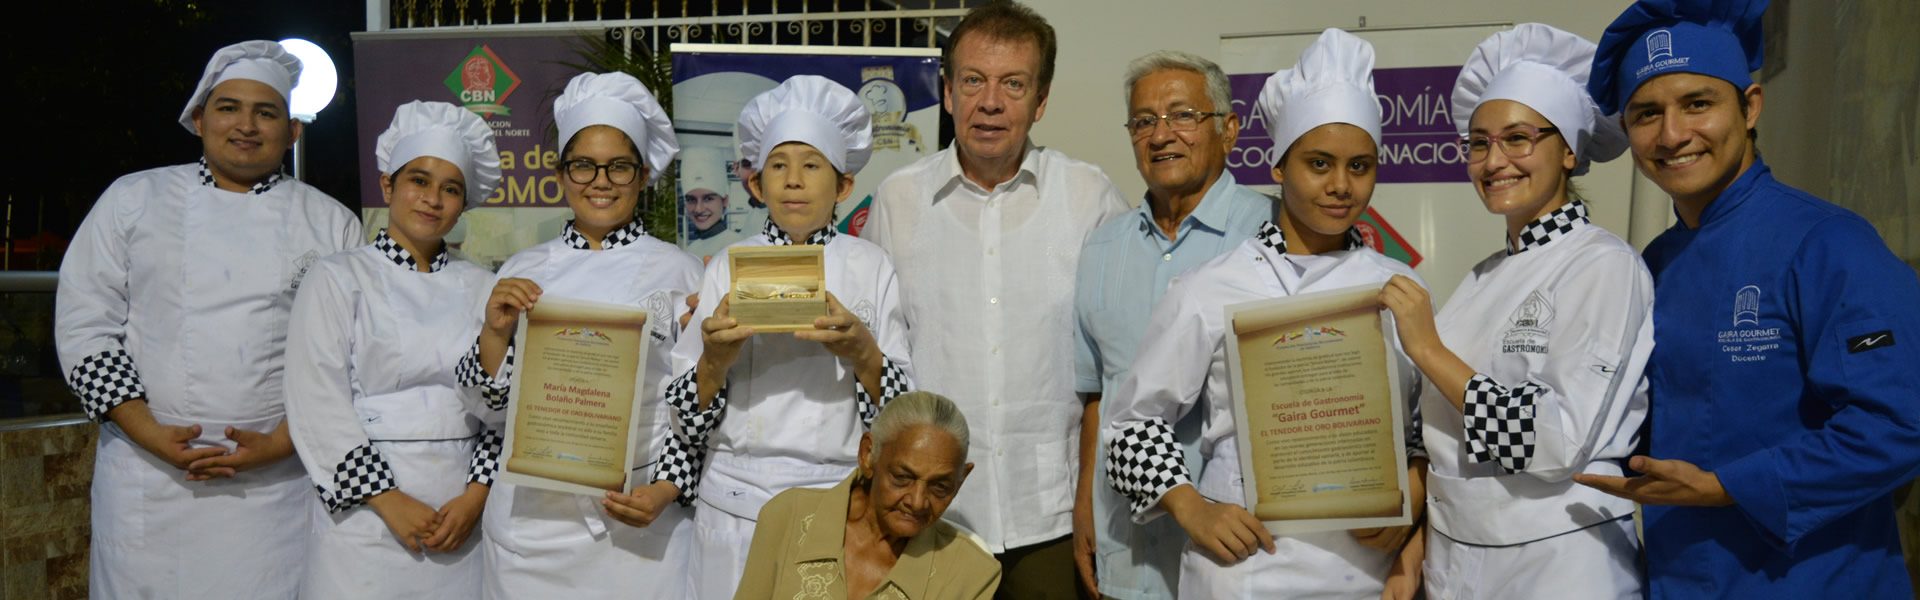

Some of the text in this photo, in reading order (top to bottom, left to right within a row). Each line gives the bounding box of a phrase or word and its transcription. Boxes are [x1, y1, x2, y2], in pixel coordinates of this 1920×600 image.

[1655, 57, 1690, 68] GOURMET
[460, 90, 496, 102] CBN
[523, 143, 559, 170] de
[1225, 146, 1275, 168] COC
[486, 176, 564, 204] SMO
[1739, 328, 1780, 338] GOURMET
[1731, 354, 1766, 362] Docente
[543, 382, 611, 398] María Magdalena
[545, 393, 606, 408] Bolaño Palmera
[1271, 394, 1365, 411] Escuela de Gastronomía
[1270, 426, 1303, 436] TENEDOR
[1314, 423, 1331, 431] ORO
[1332, 417, 1382, 429] BOLIVARIANO
